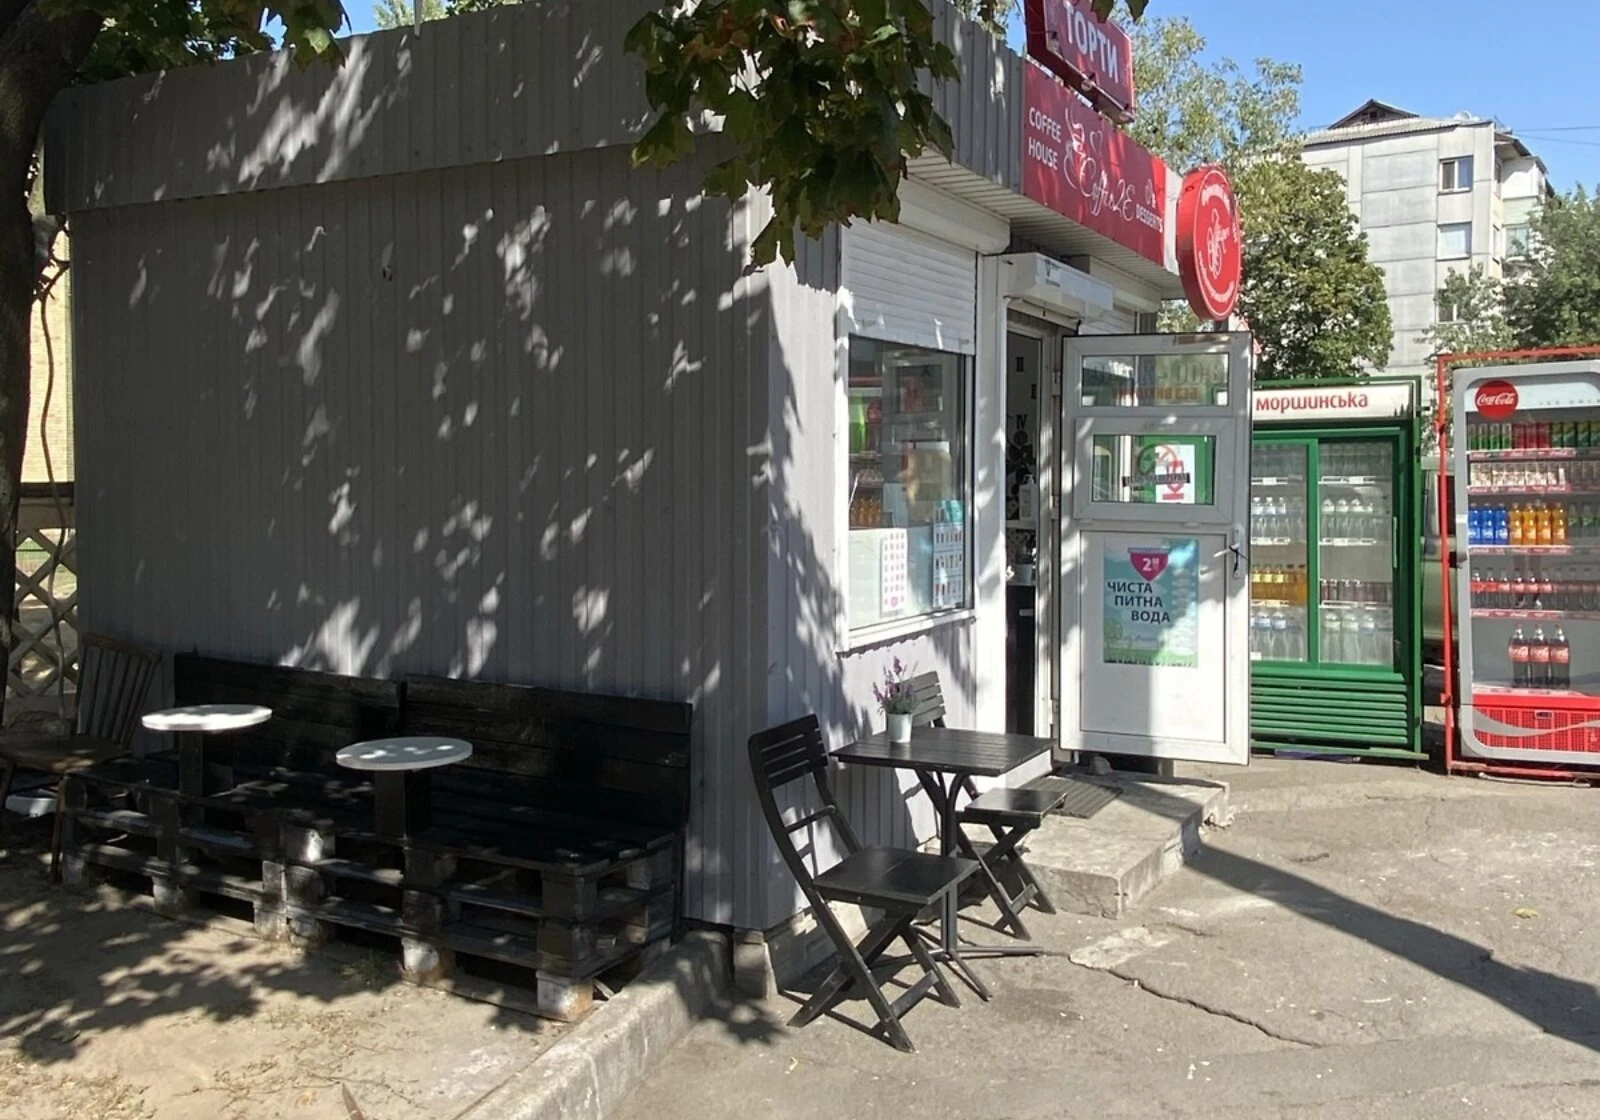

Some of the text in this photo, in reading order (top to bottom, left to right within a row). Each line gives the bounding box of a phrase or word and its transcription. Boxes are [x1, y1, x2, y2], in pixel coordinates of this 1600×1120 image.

[1063, 0, 1118, 84] ТОРТИ
[1028, 107, 1062, 143] COFFEE
[1028, 137, 1058, 170] HOUSE
[1256, 391, 1369, 414] моршинська
[1107, 581, 1153, 594] ЧИСТА
[1114, 595, 1163, 608] ПИТНА
[1131, 610, 1171, 624] ВОДА
